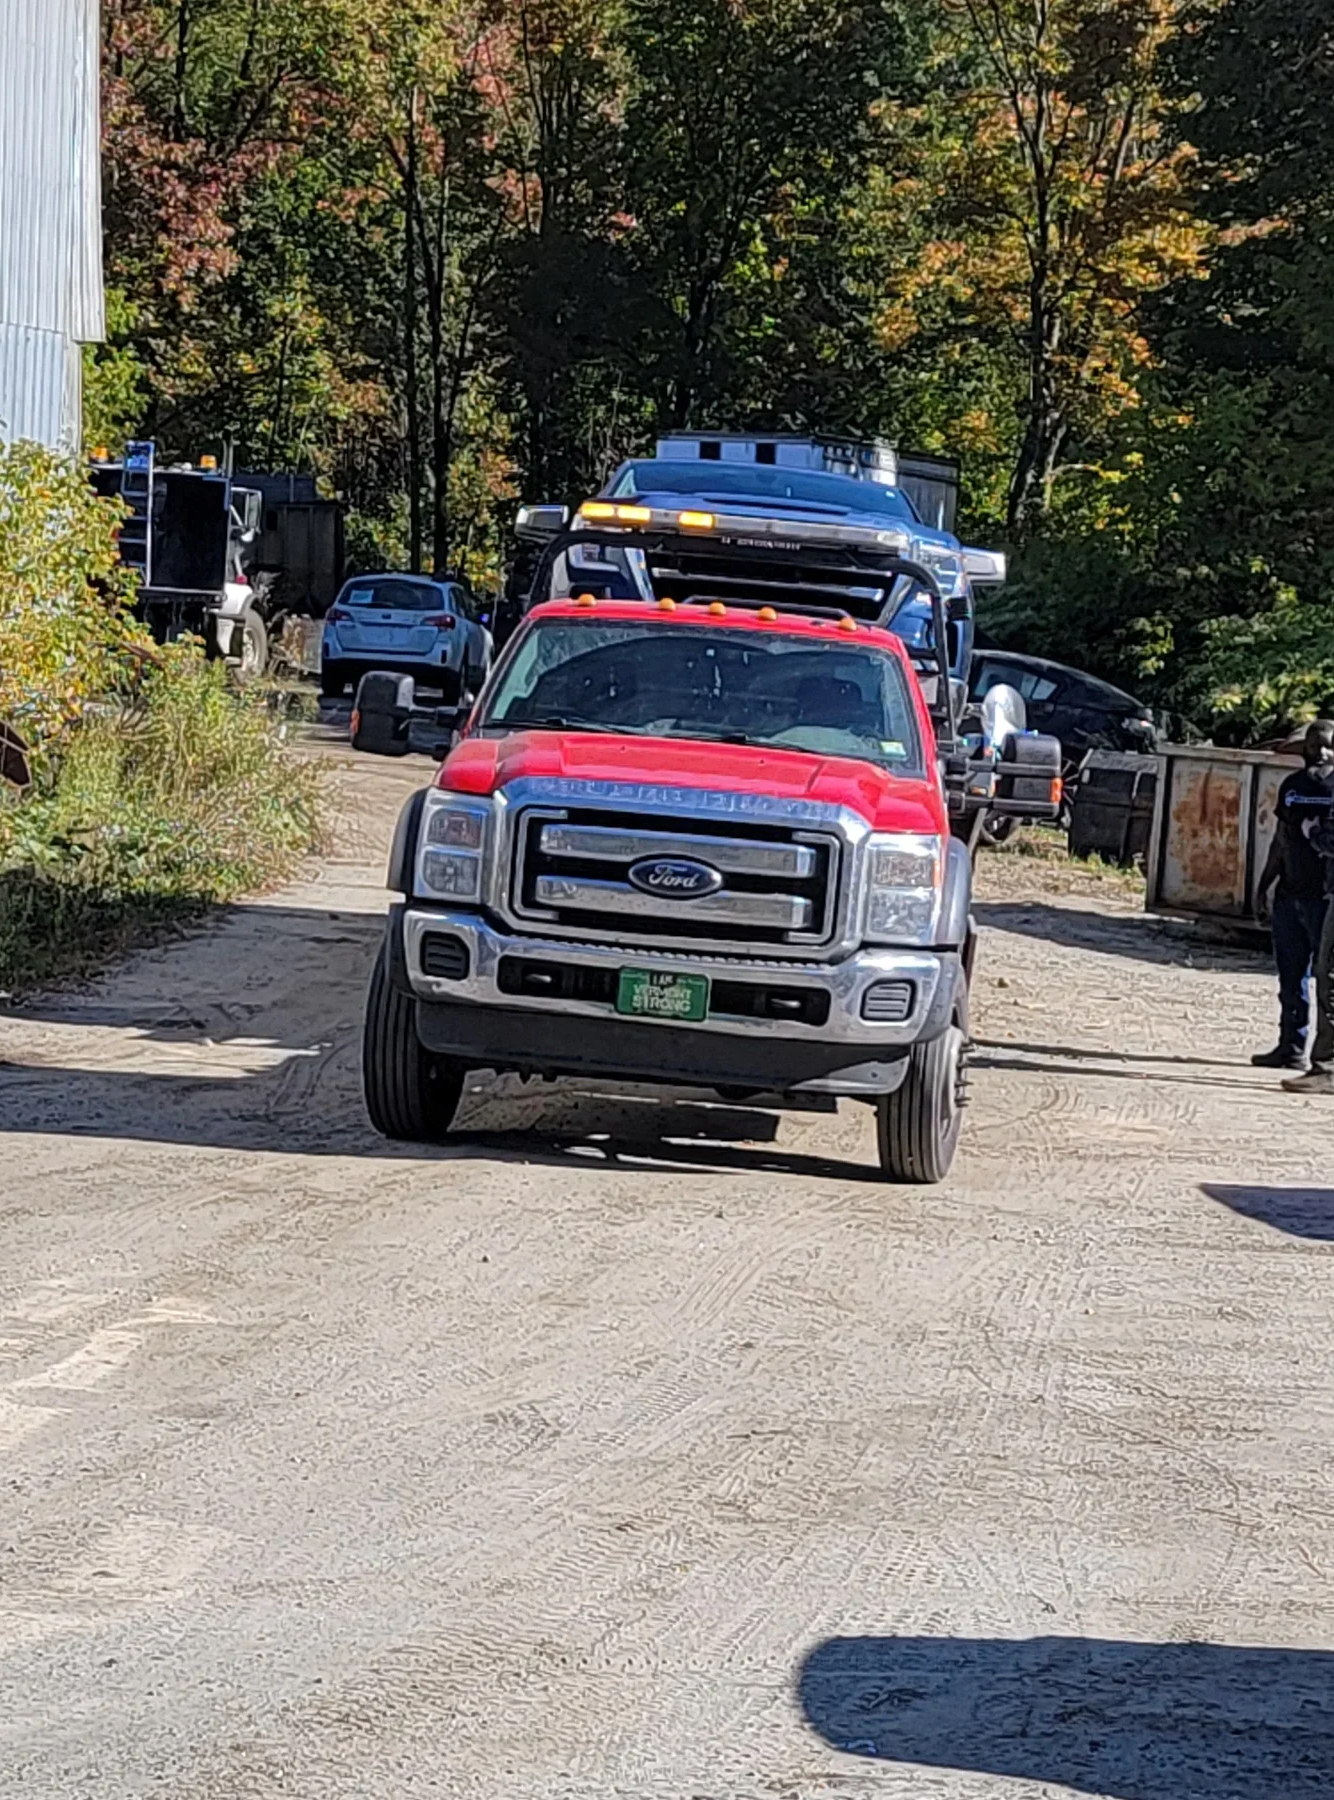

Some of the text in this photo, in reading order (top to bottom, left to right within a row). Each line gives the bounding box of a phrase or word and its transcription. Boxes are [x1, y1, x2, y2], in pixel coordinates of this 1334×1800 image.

[649, 864, 700, 888] Ford
[633, 984, 692, 1000] VERMONT
[632, 995, 691, 1012] STRONG
